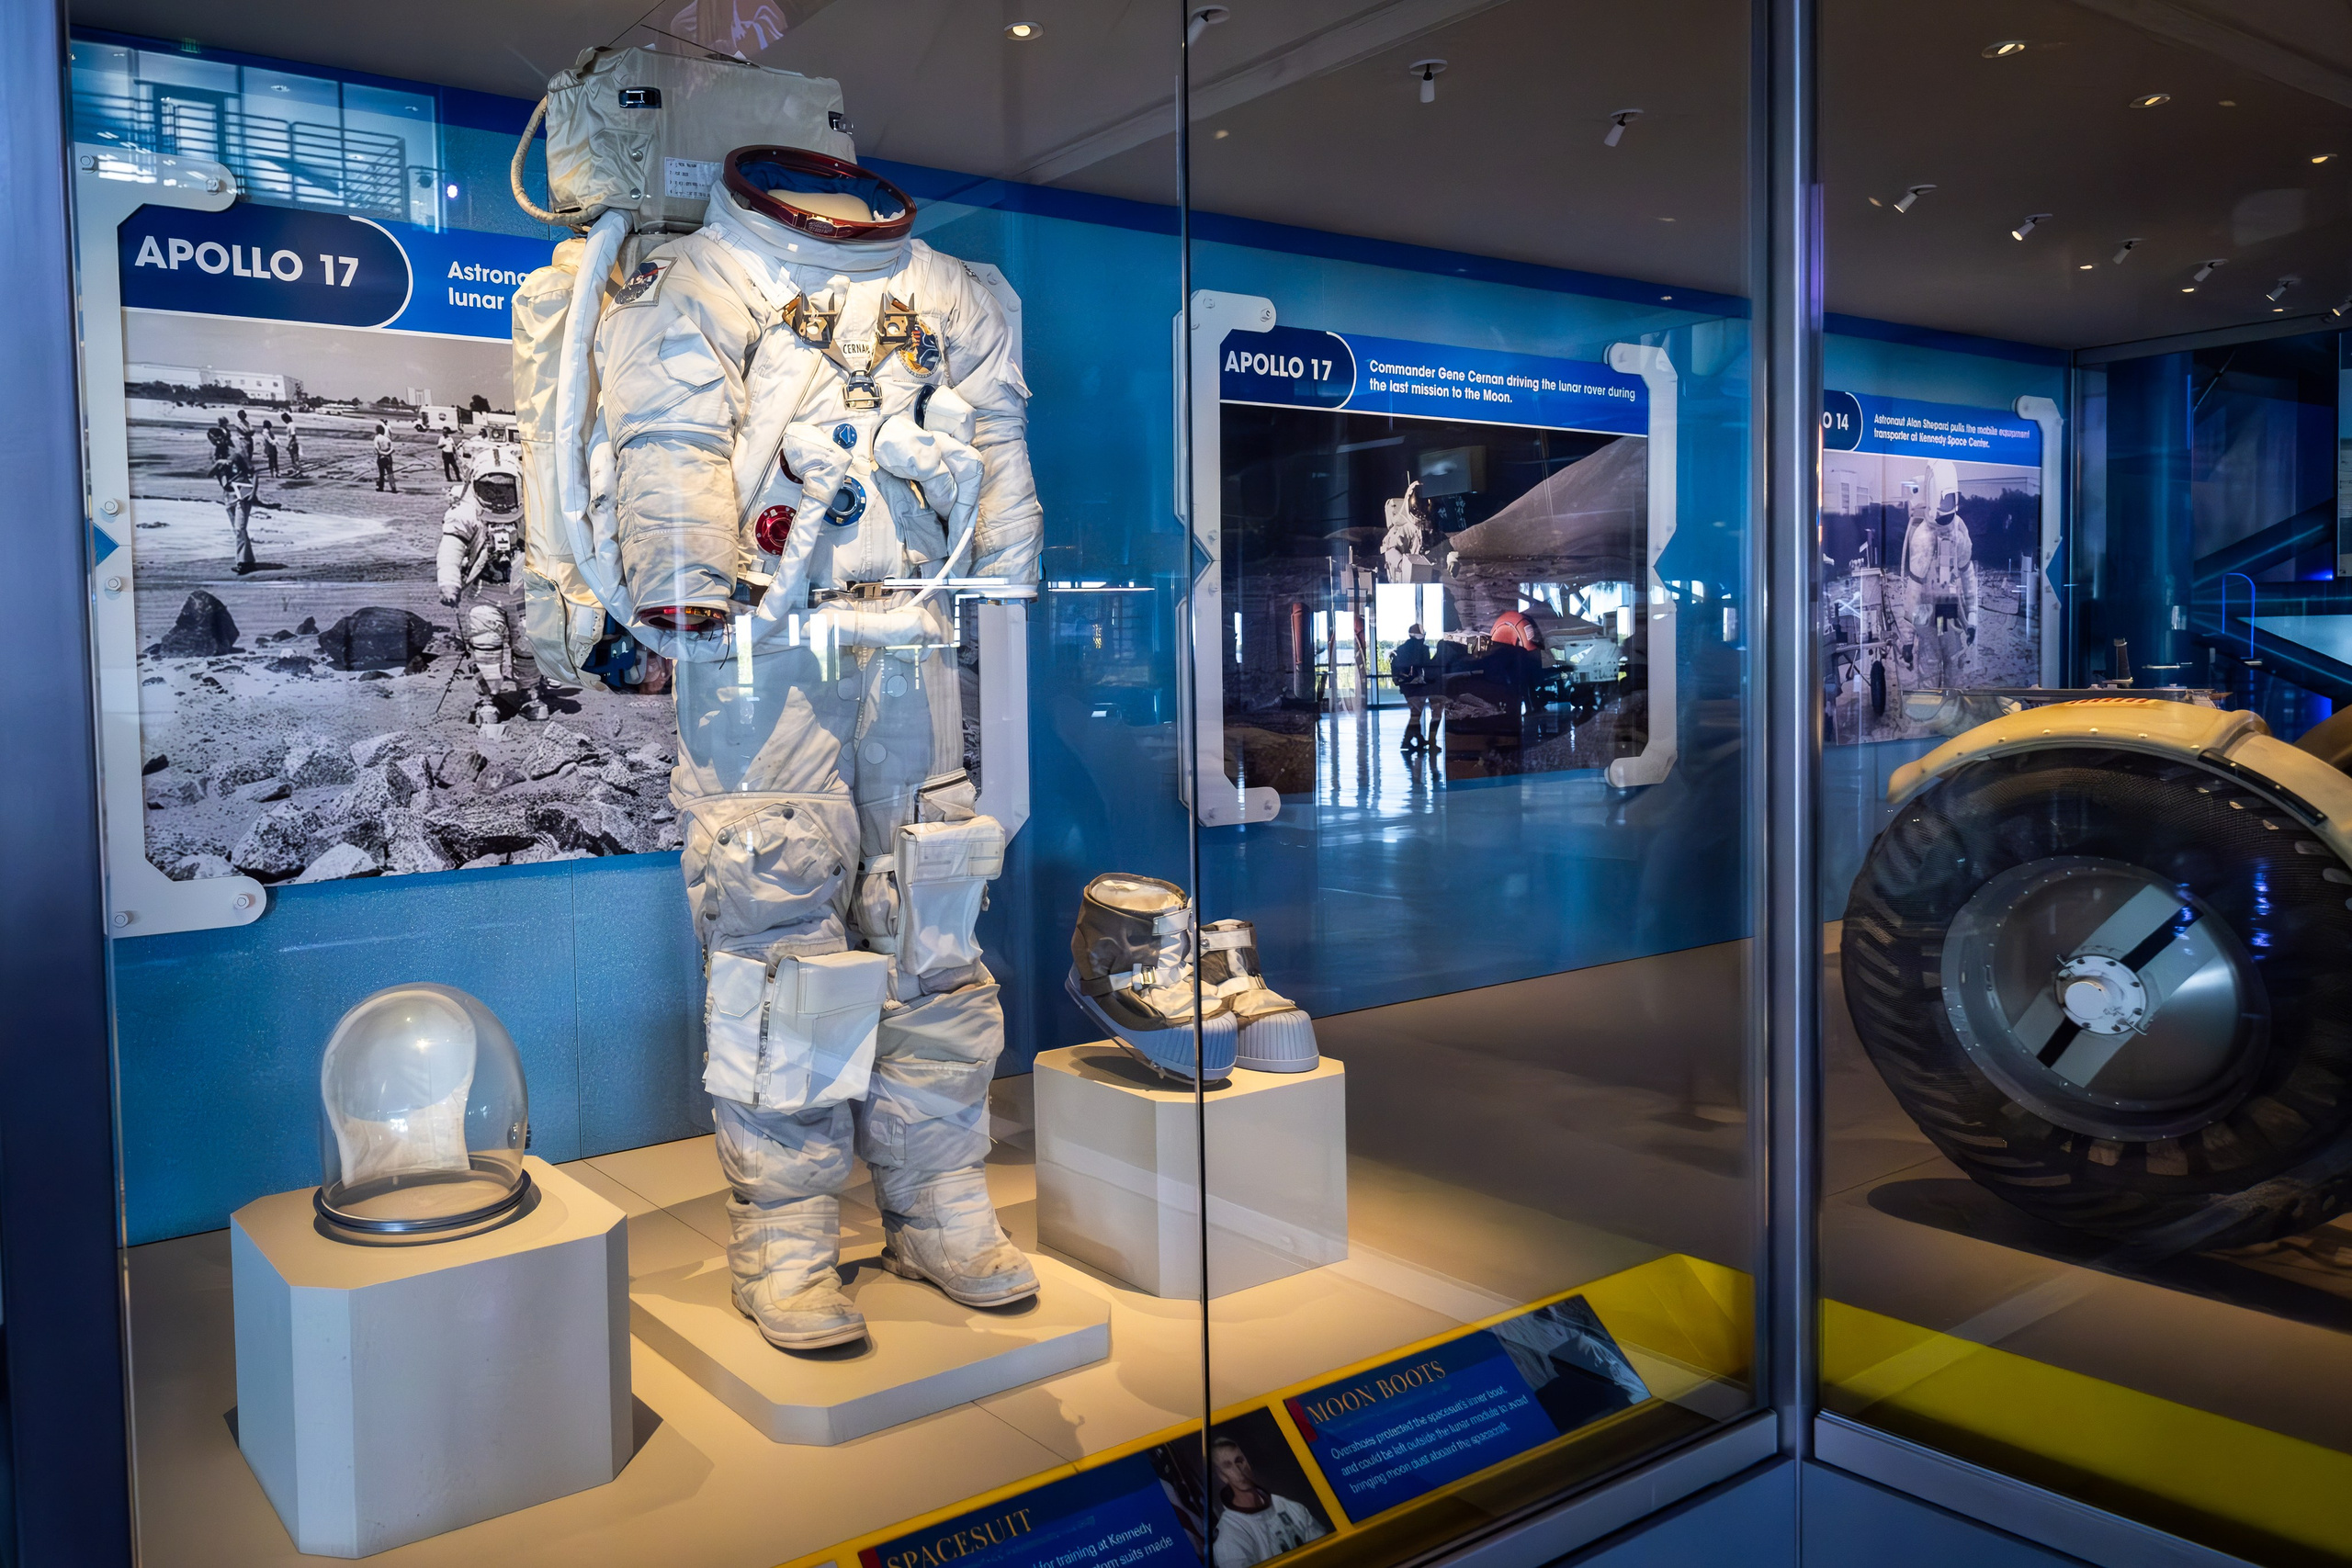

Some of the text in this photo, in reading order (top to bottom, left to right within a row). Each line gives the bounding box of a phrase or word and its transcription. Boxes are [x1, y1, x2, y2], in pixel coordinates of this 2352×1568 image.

[134, 234, 359, 288] APOLLO 17
[447, 287, 505, 310] lunar
[1225, 350, 1332, 381] APOLLO 17
[1369, 359, 1635, 402] Commander Gene Cernan driving the lunar rover during
[1369, 378, 1513, 403] the last mission to the Moon.
[1836, 412, 1849, 431] 14
[1873, 413, 1906, 426] Astronaut
[1906, 417, 1922, 428] Alan
[1922, 418, 1950, 431] Shepard
[1950, 423, 1965, 434] pulls
[1965, 423, 1976, 434] the
[1976, 425, 1998, 436] mobile
[1873, 427, 1910, 442] transporter
[1910, 431, 1918, 442] at
[1918, 433, 1947, 446] Kennedy
[1947, 434, 1967, 447] Space
[1306, 1385, 1377, 1425] MOON
[1375, 1360, 1447, 1399] BOOTS
[1330, 1436, 1376, 1460] Overshoes
[1375, 1419, 1414, 1444] protected
[1412, 1416, 1428, 1427] the
[1466, 1392, 1488, 1406] inner
[1341, 1461, 1360, 1476] and
[1358, 1451, 1383, 1470] could
[1380, 1450, 1395, 1461] be
[1391, 1442, 1408, 1456] left
[1406, 1432, 1436, 1450] outside
[1435, 1427, 1451, 1439] the
[1448, 1419, 1471, 1434] lunar
[1469, 1406, 1500, 1426] module
[1498, 1404, 1509, 1415] to
[1349, 1472, 1388, 1494] bringing
[1385, 1462, 1412, 1479] moon
[1410, 1454, 1431, 1469] dust
[1429, 1441, 1459, 1461] aboard
[1455, 1438, 1472, 1450] the
[887, 1508, 1034, 1568] SPACESUIT
[1056, 1544, 1098, 1567] training
[1097, 1538, 1110, 1551] at
[1107, 1522, 1153, 1547] Kennedy
[1119, 1548, 1145, 1565] suits
[1144, 1536, 1174, 1557] made
